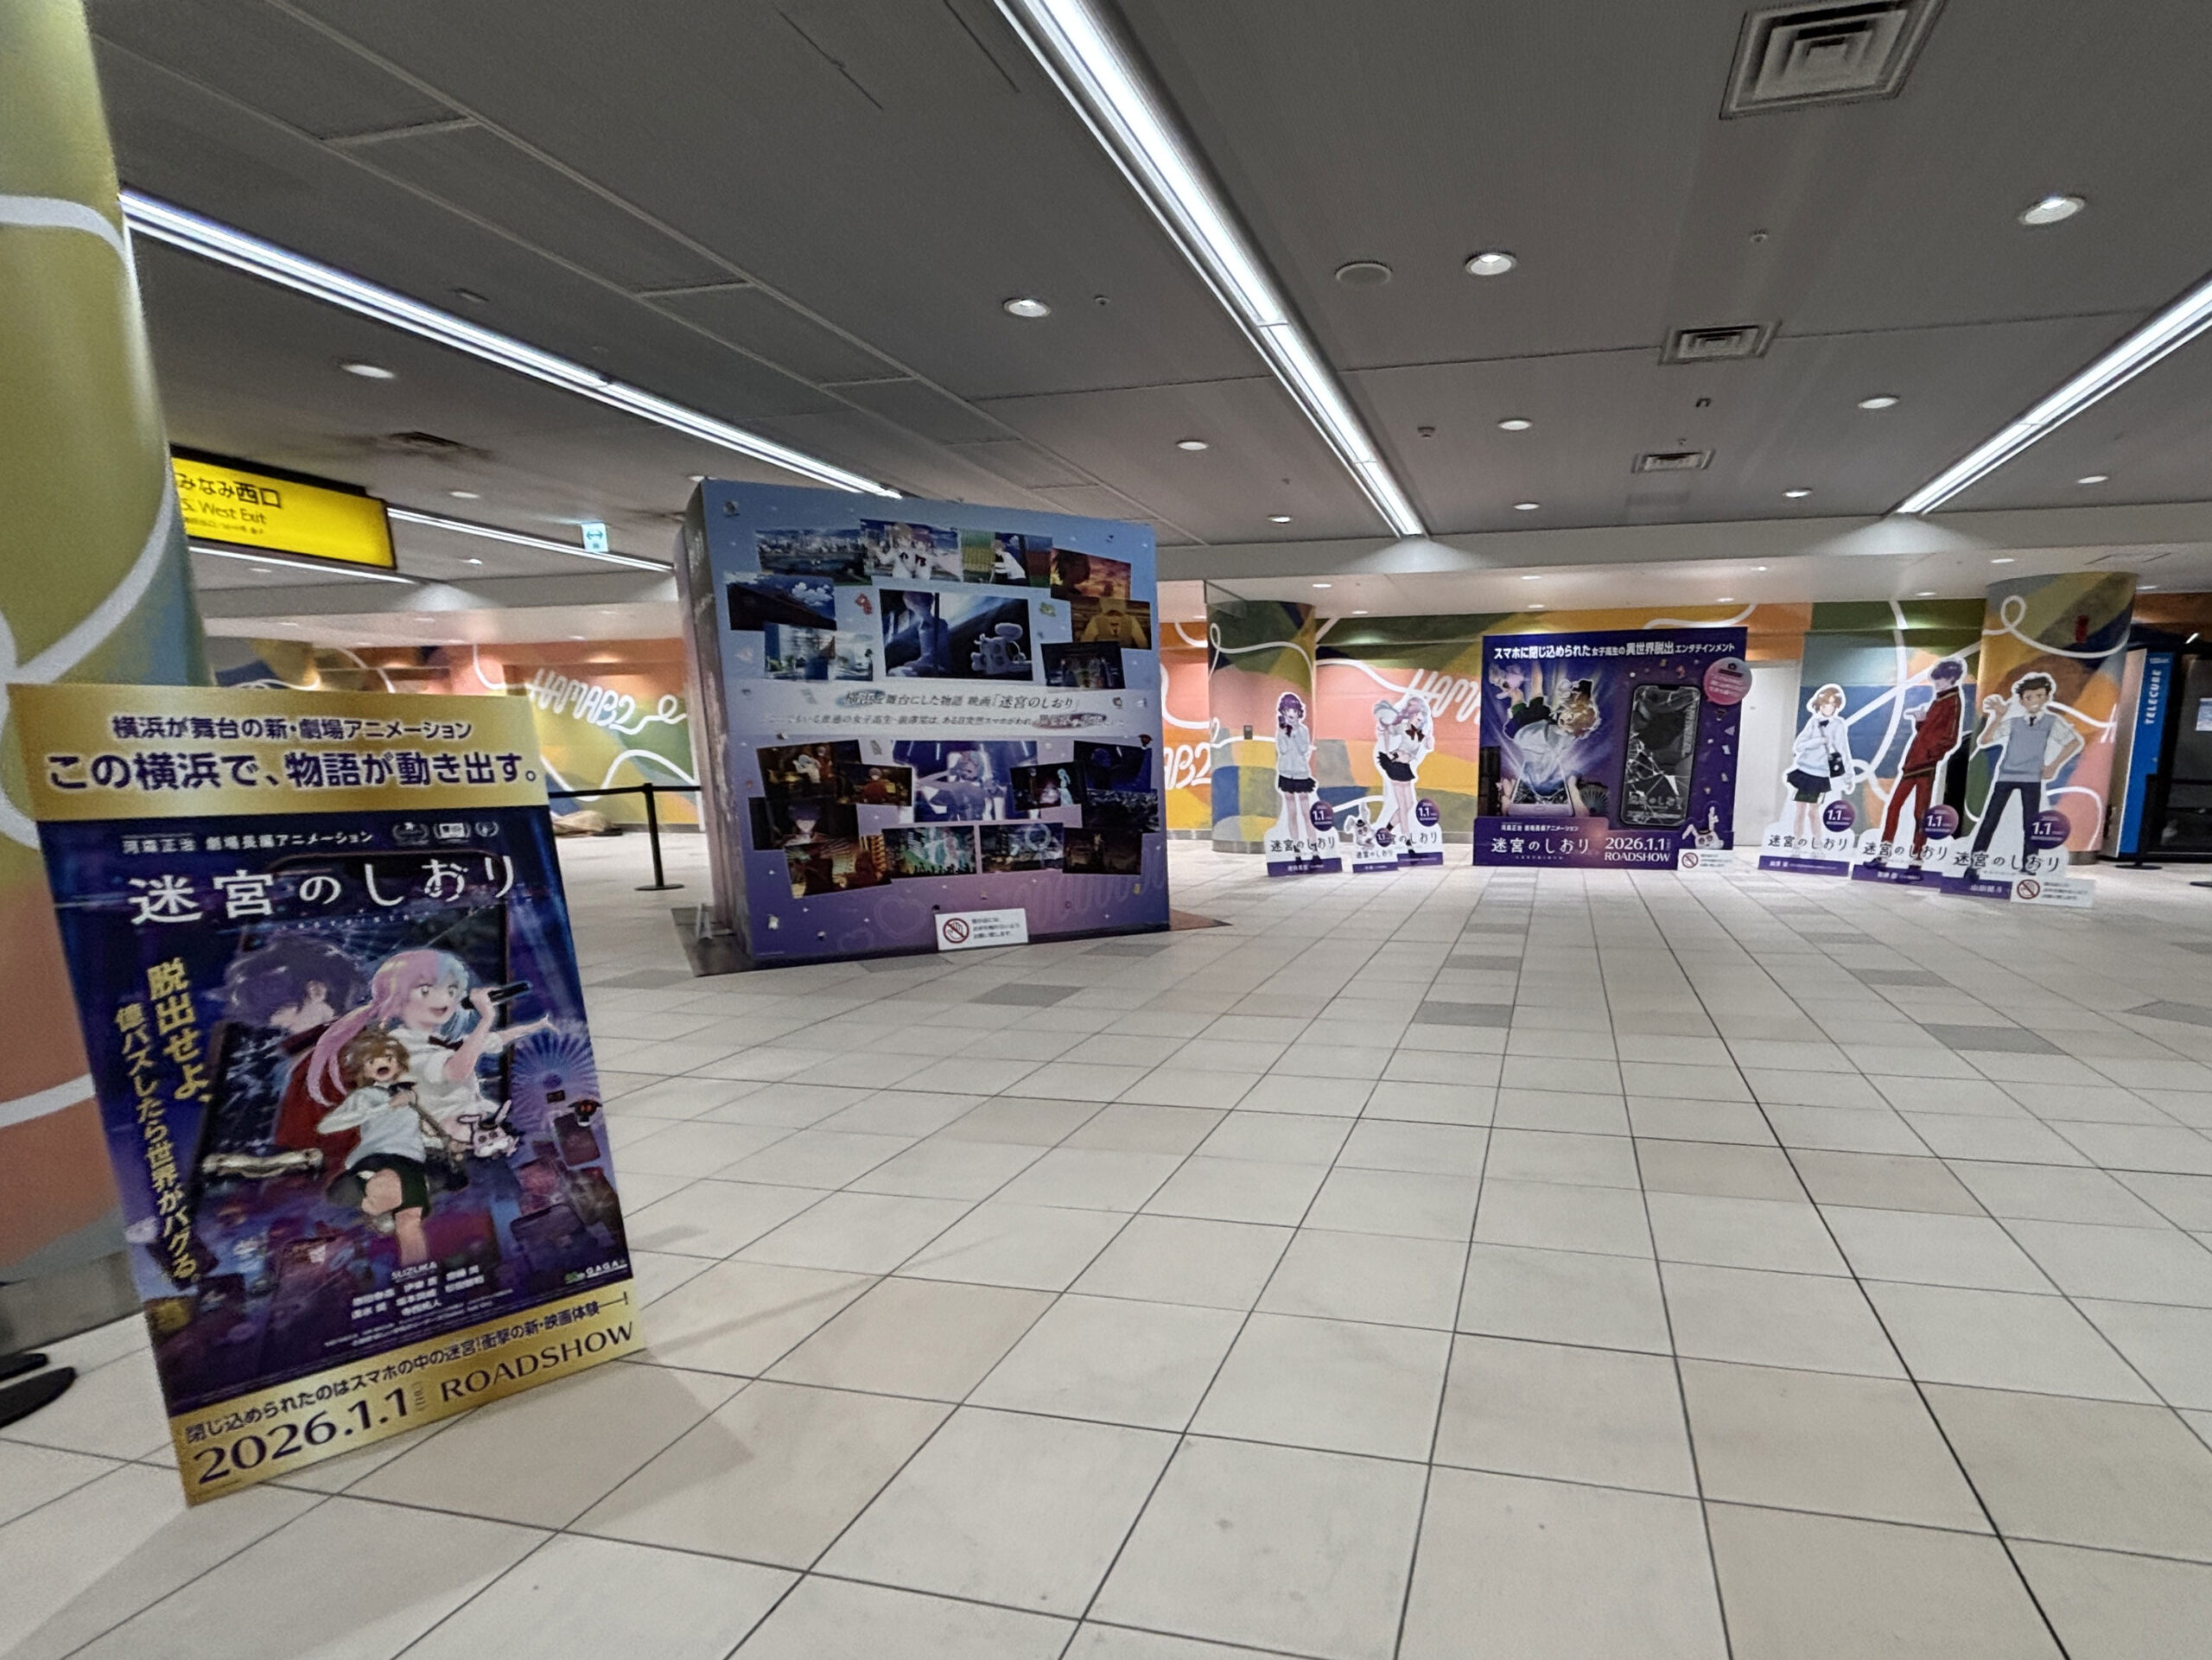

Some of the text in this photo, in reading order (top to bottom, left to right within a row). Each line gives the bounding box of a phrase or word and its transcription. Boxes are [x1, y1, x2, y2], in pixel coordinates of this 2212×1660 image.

[198, 500, 237, 518] West
[240, 507, 267, 525] Exit
[2145, 669, 2161, 724] TELECUBE
[47, 751, 537, 792] この横浜で、物語が動き出す。
[1491, 836, 1590, 855] 迷宮のしおり
[1605, 836, 1666, 851] 2026.1.1
[1768, 834, 1848, 852] 迷宮のしおり
[1862, 841, 1948, 862] 迷宮のしおり
[1605, 852, 1671, 862] ROADSHOW
[1953, 851, 2060, 874] 迷宮のしおり
[128, 855, 514, 925] 迷宮のしおり
[391, 1261, 438, 1280] SUZUKA
[586, 1261, 619, 1275] GAGA
[194, 1321, 632, 1485] 2026.1.1 ROADSHOW
